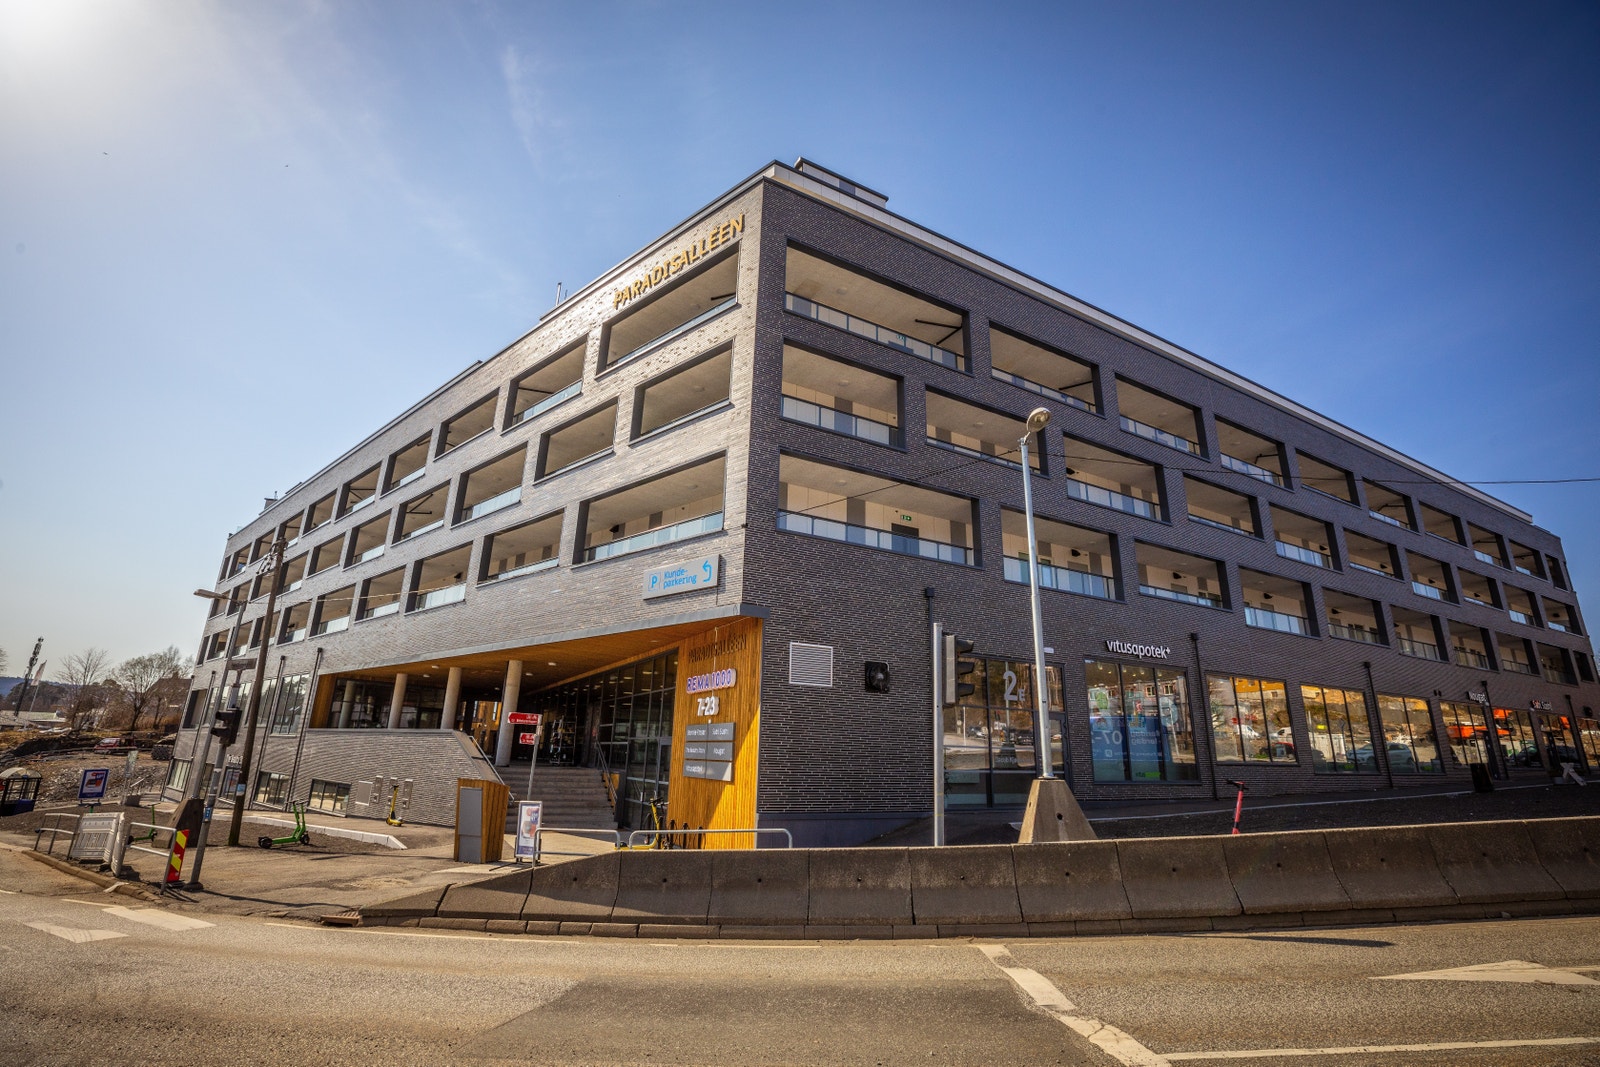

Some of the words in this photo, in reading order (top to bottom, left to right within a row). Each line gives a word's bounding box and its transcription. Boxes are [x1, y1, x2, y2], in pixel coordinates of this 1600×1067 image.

[613, 213, 744, 309] PARADISALLÉEN
[651, 575, 658, 588] P
[663, 574, 698, 589] parkering
[687, 673, 710, 694] REMA
[711, 668, 734, 690] 1000
[697, 695, 716, 716] 7-23
